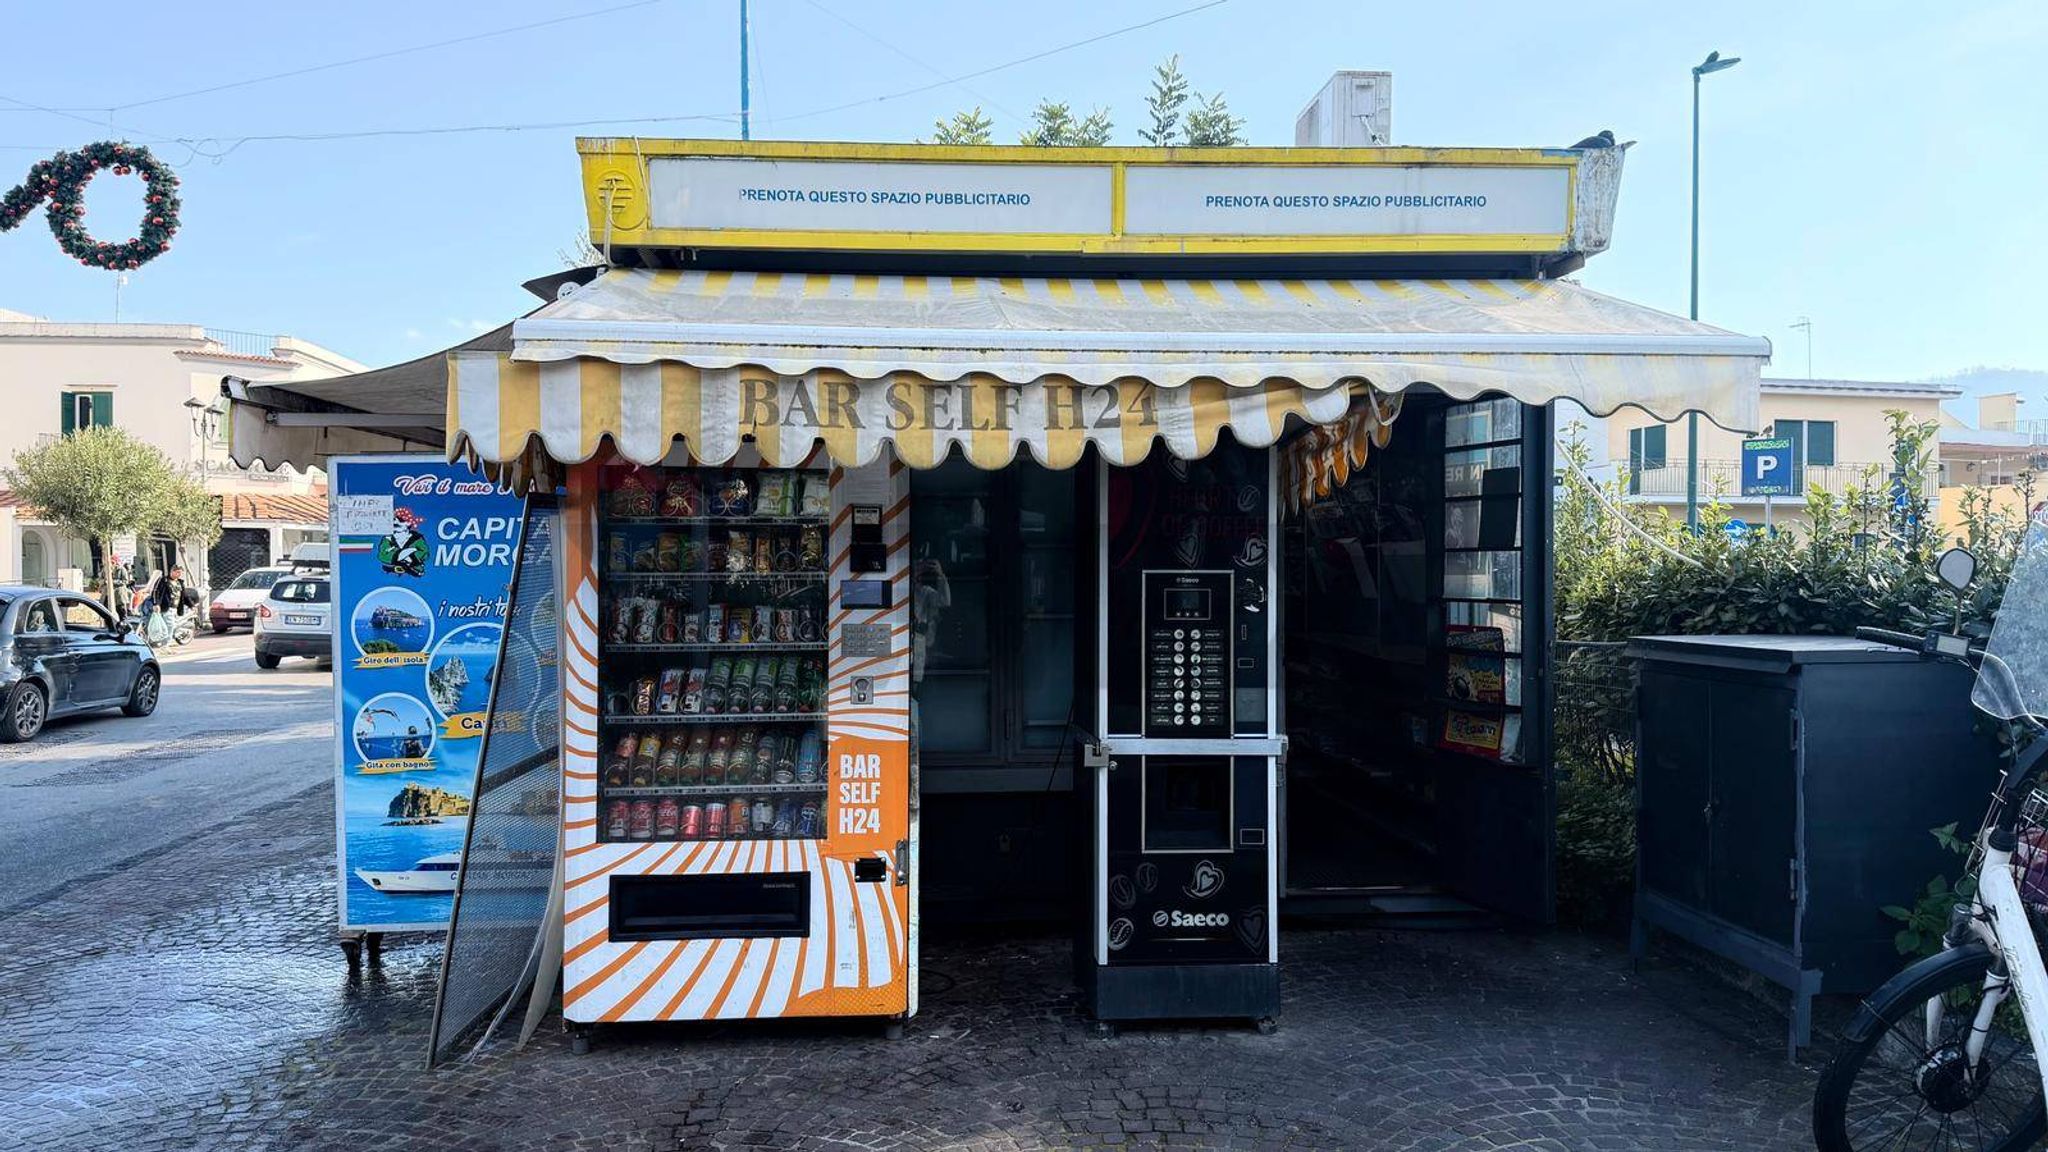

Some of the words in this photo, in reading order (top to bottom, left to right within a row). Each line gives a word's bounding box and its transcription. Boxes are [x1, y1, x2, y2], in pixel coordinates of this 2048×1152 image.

[740, 189, 805, 201] PRENOTA
[808, 191, 867, 204] QUESTO
[871, 192, 921, 205] SPAZIO
[925, 193, 1030, 206] PUBBLICITARIO
[1205, 195, 1270, 208] PRENOTA
[1273, 195, 1329, 208] QUESTO
[1332, 195, 1381, 208] SPAZIO
[1385, 195, 1487, 208] PUBBLICITARIO
[739, 378, 867, 430] BAR
[885, 381, 1024, 432] SELF
[1043, 381, 1158, 432] H24
[1757, 455, 1778, 480] P
[395, 474, 437, 496] Vivi
[436, 478, 451, 495] il
[453, 482, 493, 495] mare
[449, 597, 492, 617] nostri
[363, 656, 383, 664] Giro
[366, 761, 384, 769] Gita
[403, 759, 430, 770] bagno
[840, 754, 881, 779] BAR
[839, 782, 881, 804] SELF
[839, 807, 880, 834] H24
[1171, 910, 1230, 927] Saeco
